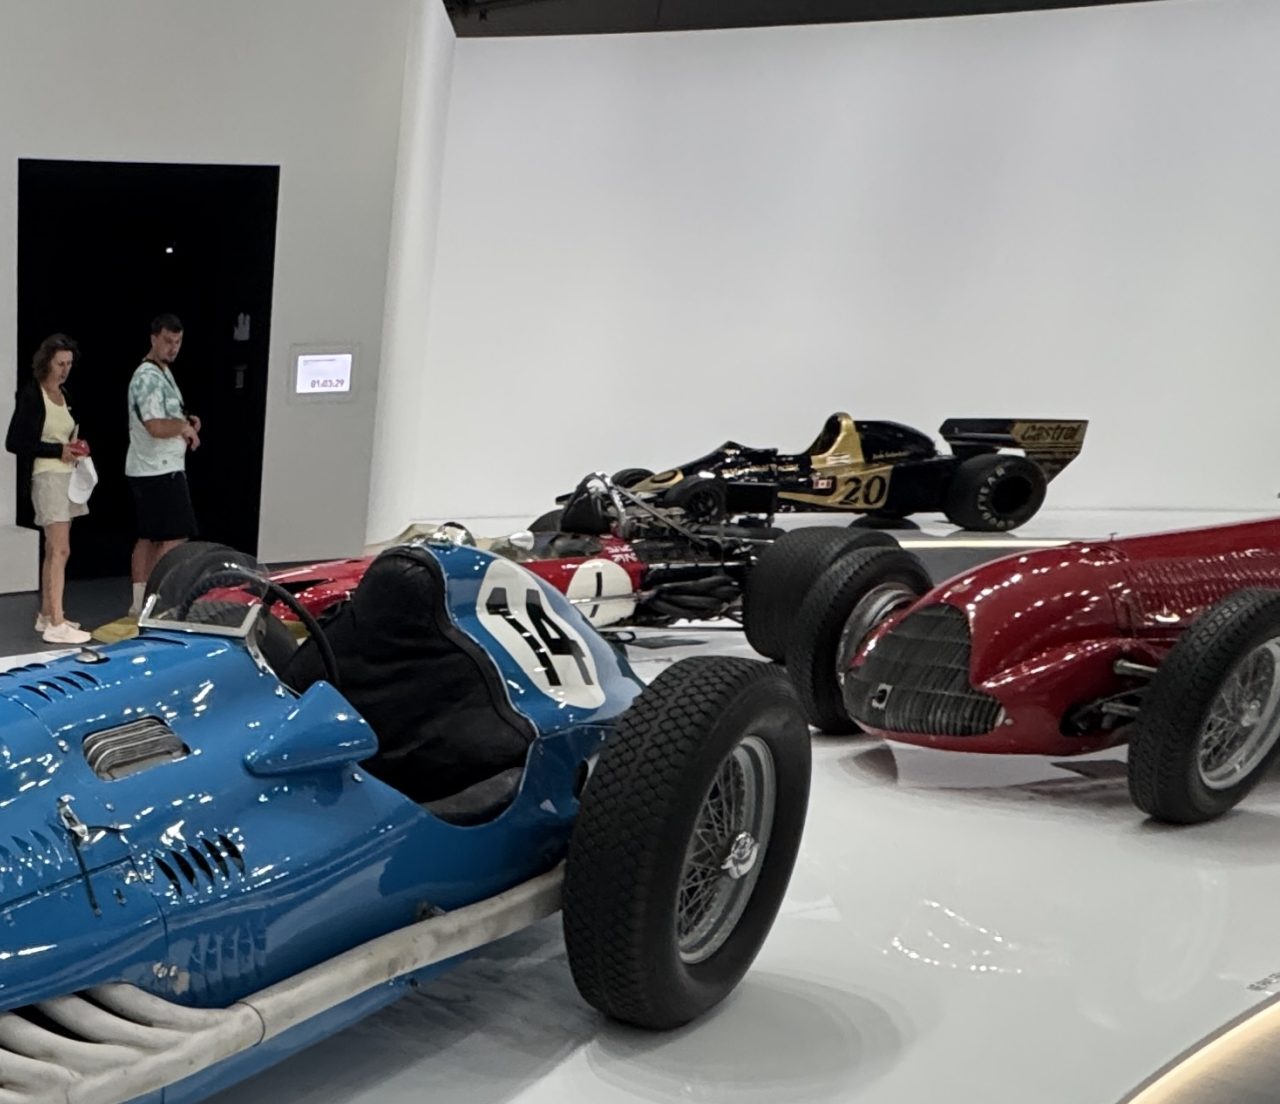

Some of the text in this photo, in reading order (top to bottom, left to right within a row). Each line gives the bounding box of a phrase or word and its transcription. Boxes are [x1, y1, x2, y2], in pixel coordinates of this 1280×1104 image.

[840, 474, 887, 505] 20
[588, 571, 603, 618] 1
[485, 586, 595, 687] 14
